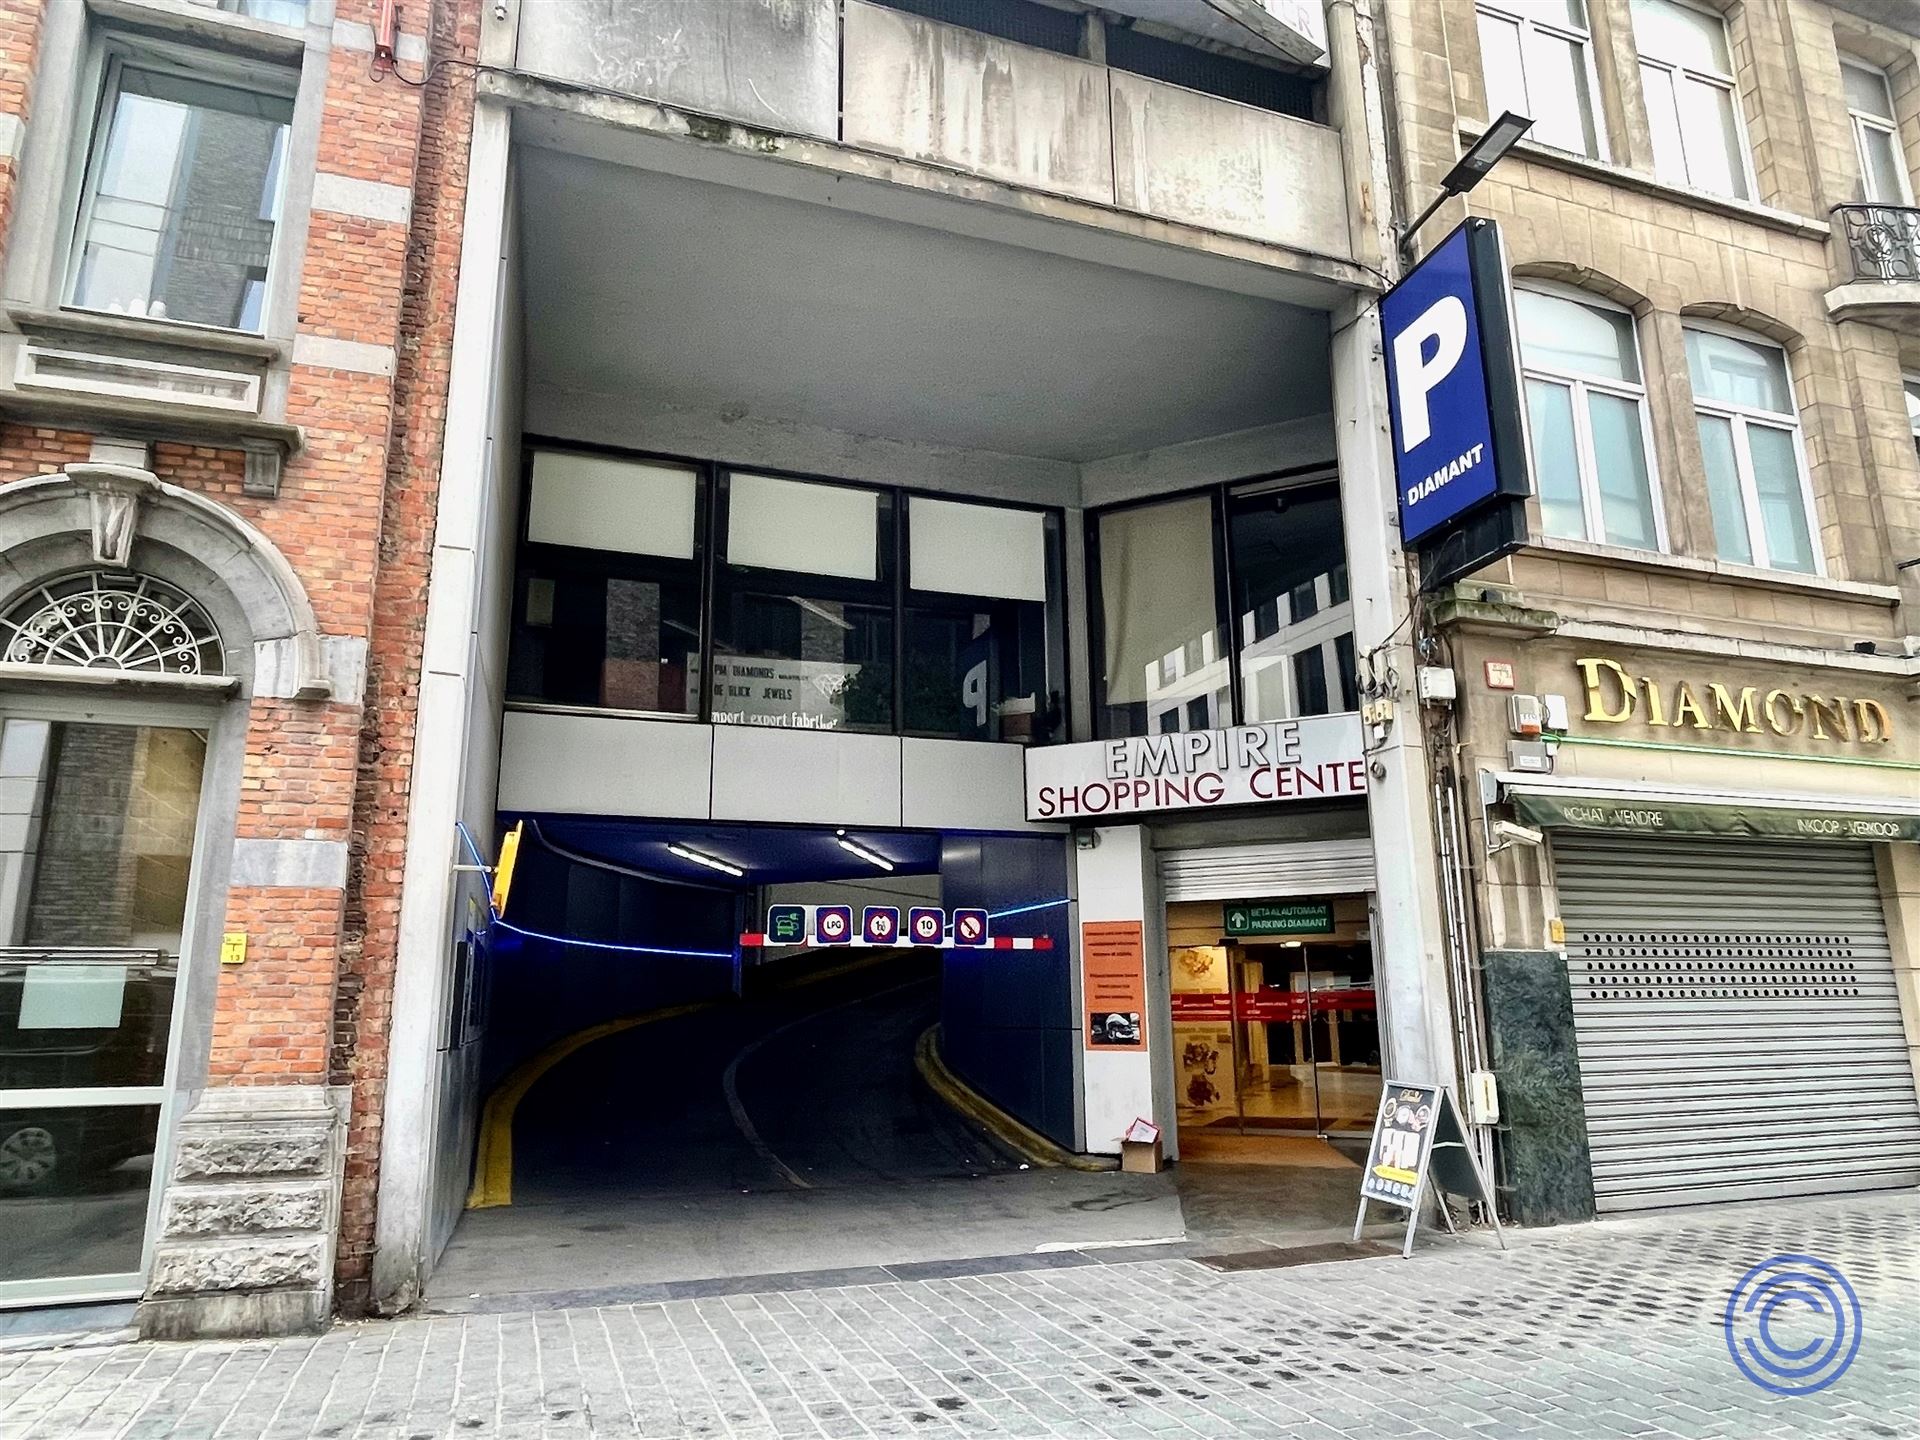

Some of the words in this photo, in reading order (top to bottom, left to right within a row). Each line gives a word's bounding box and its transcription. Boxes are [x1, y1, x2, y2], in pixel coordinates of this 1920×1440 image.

[1393, 295, 1468, 454] P
[1407, 442, 1484, 507] DIAMANT
[732, 665, 775, 680] DIAMONDS
[762, 687, 793, 700] JEWELS
[1104, 721, 1301, 780] EMPIRE
[1038, 773, 1225, 818] SHOPPING
[1562, 806, 1605, 822] ACHAT
[1613, 809, 1664, 827] VENDRE
[1797, 817, 1840, 834] INKOOP
[1850, 819, 1900, 837] VERKOOP
[825, 920, 842, 930] LPG
[920, 920, 933, 930] 10
[1251, 919, 1287, 929] PARKING
[1287, 918, 1328, 928] DIAMANT
